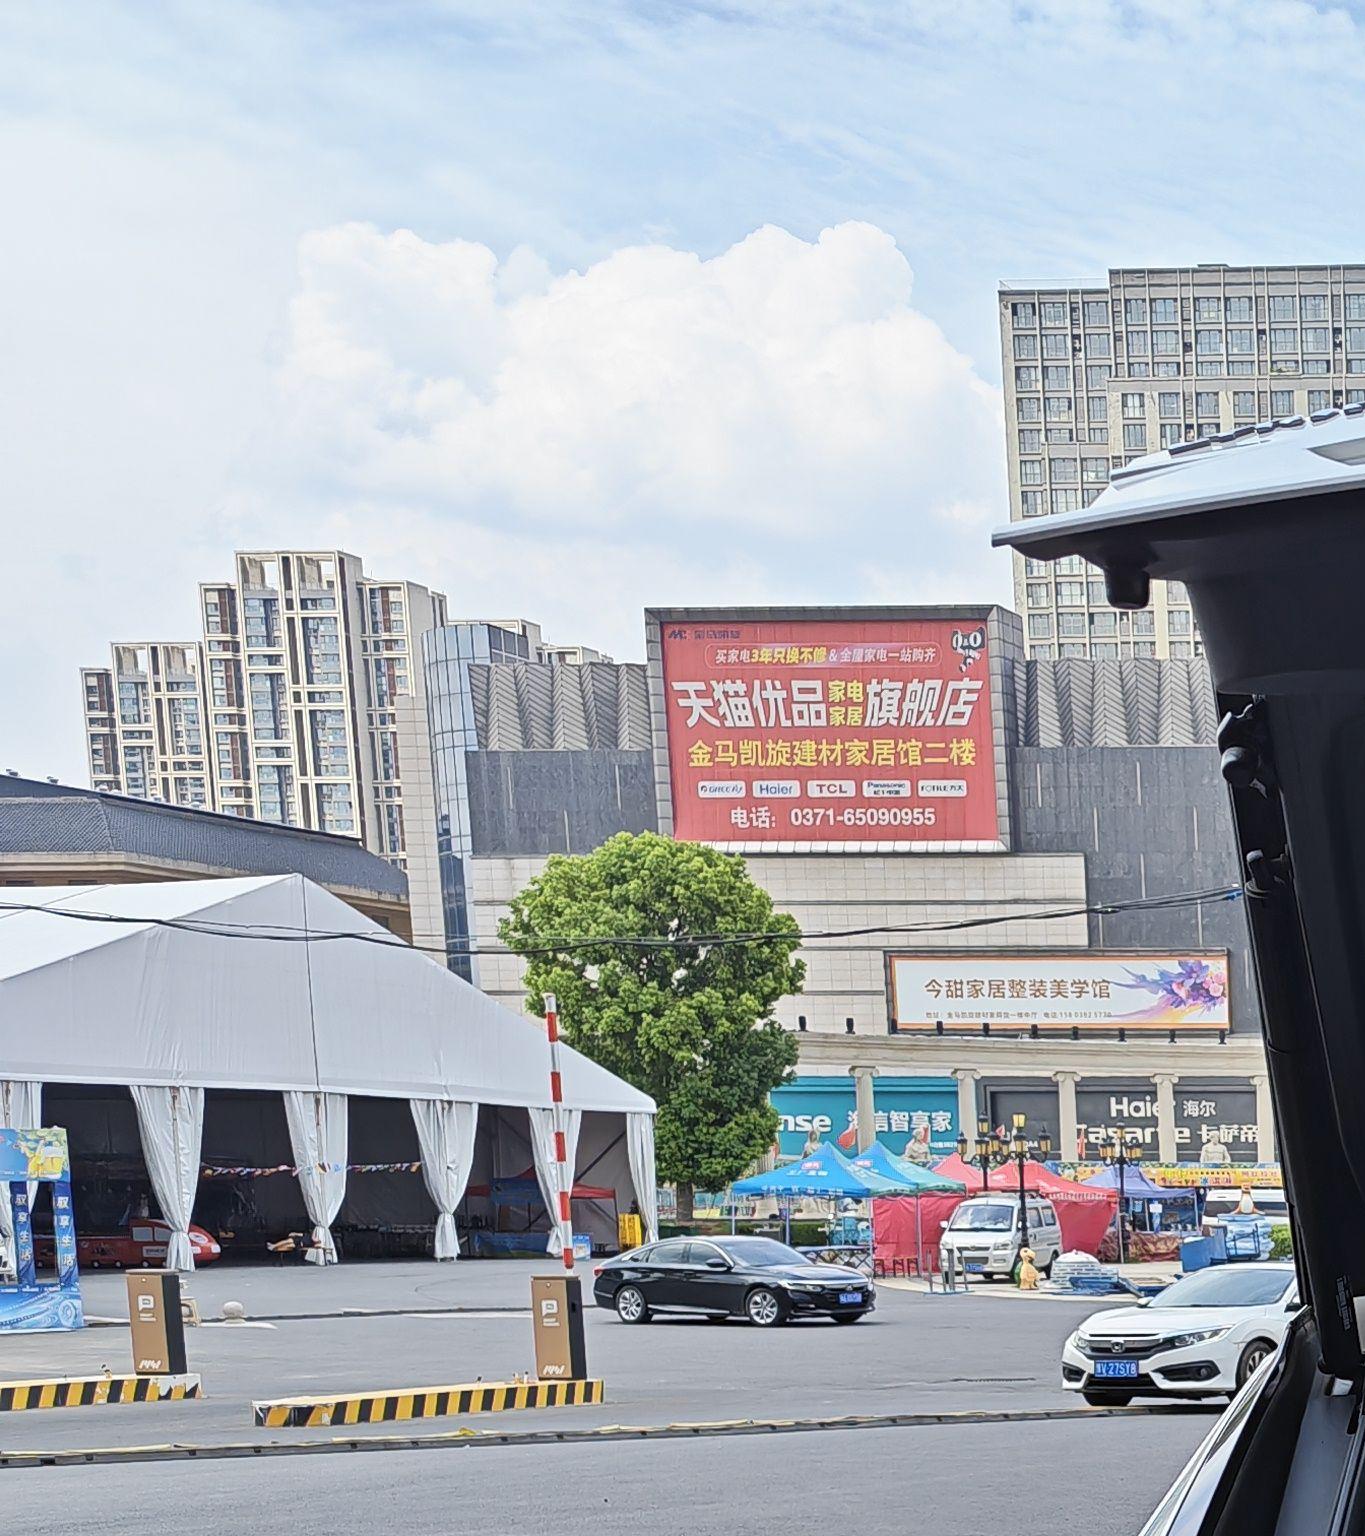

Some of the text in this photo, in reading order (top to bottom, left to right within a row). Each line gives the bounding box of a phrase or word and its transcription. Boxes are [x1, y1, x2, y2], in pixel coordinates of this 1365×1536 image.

[828, 680, 864, 703] 家电
[864, 677, 983, 727] 旗舰店
[671, 679, 827, 728] 天猫优品
[829, 706, 863, 727] 家居
[688, 738, 977, 768] 金马凯旋建材家居馆二楼
[759, 783, 793, 795] Haier
[816, 783, 847, 794] TCL
[790, 808, 936, 827] 0371-65090955
[924, 978, 1111, 999] 今甜家居整装美学馆
[1109, 1095, 1217, 1117] Haie 海尔
[778, 1114, 832, 1132] nse
